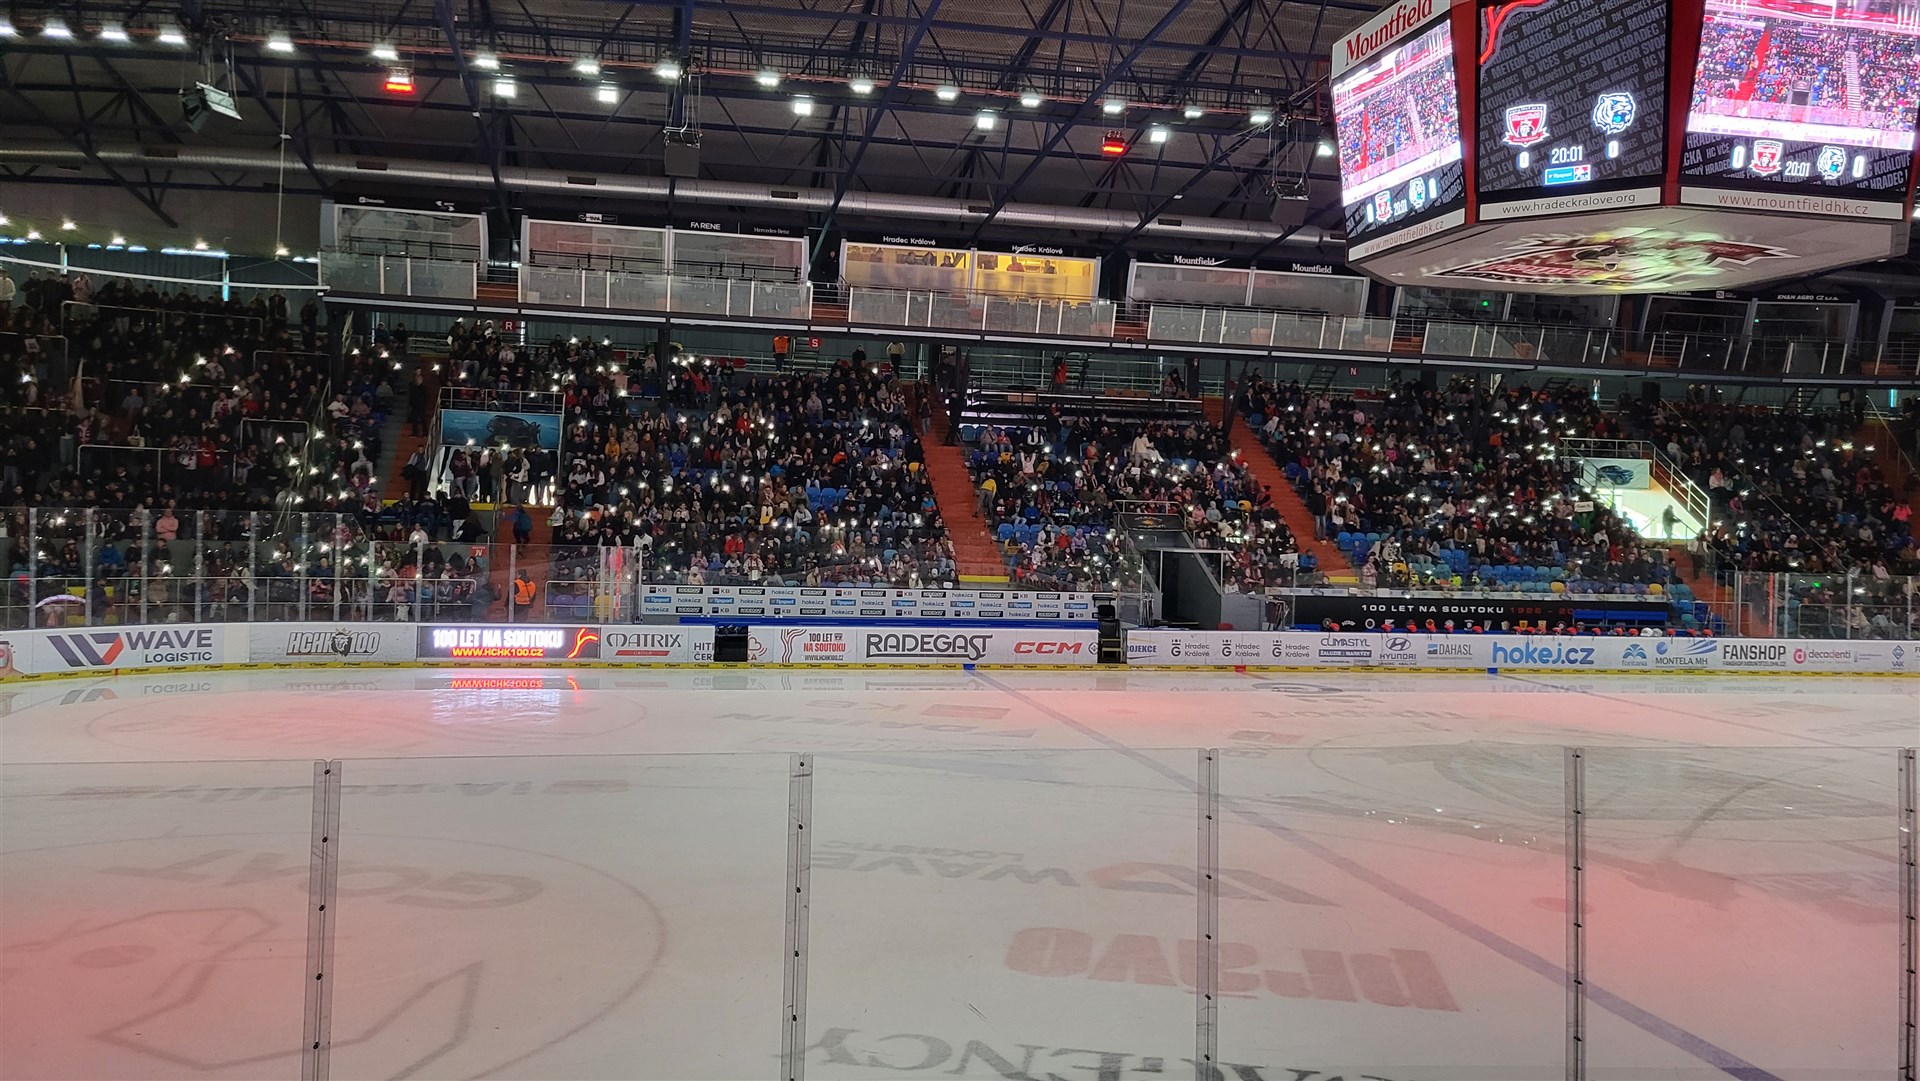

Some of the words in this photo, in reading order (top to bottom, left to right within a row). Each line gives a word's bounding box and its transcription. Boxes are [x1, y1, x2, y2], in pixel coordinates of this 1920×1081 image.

[1522, 1, 1579, 36] MOUNTFIELD
[1345, 0, 1432, 66] Mountfield
[1517, 28, 1553, 53] HRADEC
[1491, 55, 1528, 79] METEOR
[1527, 30, 1577, 63] SVOBODNÉ
[1576, 16, 1607, 40] DVORY
[1563, 38, 1595, 59] SPARTAK
[1595, 25, 1624, 45] HRADEC
[1579, 40, 1620, 68] STADION
[1620, 23, 1660, 50] HRADEC
[1601, 46, 1641, 73] METEOR
[1642, 54, 1658, 70] HC
[1522, 64, 1536, 80] HC
[1610, 63, 1640, 82] HRADEC
[1546, 78, 1573, 97] SPARTA
[1485, 84, 1524, 110] KUKLENY
[1553, 113, 1589, 137] HRADEC
[1551, 146, 1583, 164] 20:01
[1608, 141, 1618, 158] 0
[1732, 146, 1745, 169] 0
[1520, 151, 1529, 168] 0
[1853, 155, 1865, 178] 0
[1484, 167, 1498, 181] HC
[1497, 160, 1513, 175] LEV
[1785, 161, 1811, 177] 20:01
[1870, 171, 1904, 190] HRADEC
[1502, 192, 1636, 214] www.hradeckralove.org
[1718, 193, 1869, 215] www.mountfieldhk.cz
[753, 227, 790, 235] Mercedes-Benz
[1364, 220, 1444, 254] www.mountfieldhk.cz
[883, 236, 909, 244] Hradec
[910, 237, 936, 246] Králové
[1038, 246, 1063, 255] Králové
[1173, 255, 1216, 266] Mountfield
[1292, 263, 1333, 274] Mountfield
[505, 321, 513, 330] R
[811, 338, 819, 347] S
[1350, 367, 1357, 375] N
[1361, 604, 1386, 612] 100
[1419, 605, 1437, 613] NA
[1442, 606, 1505, 614] SOUTOKU
[125, 629, 213, 650] WAVE
[433, 629, 458, 648] 100
[460, 629, 482, 648] LET
[483, 629, 502, 648] NA
[504, 629, 563, 648] SOUTOKU
[606, 633, 682, 648] MATRIX
[809, 633, 821, 642] 100
[822, 633, 833, 642] LET
[1321, 638, 1370, 647] CLIMASTYL
[452, 648, 544, 657] WWW.HCHK100.CZ
[804, 643, 813, 652] NA
[814, 643, 846, 652] SOUTOKU
[866, 633, 993, 661] RADEGAST
[1014, 642, 1082, 654] CCM
[1127, 645, 1157, 653] OJEKCE
[1438, 643, 1473, 656] DAHASL
[1492, 641, 1595, 665] hokej.cz
[1723, 644, 1786, 660] FANSHOP
[1808, 649, 1851, 659] decadenti
[145, 651, 213, 663] LOGISTIC
[1655, 657, 1693, 665] MONTELA
[1695, 657, 1708, 665] MH
[821, 840, 1024, 861] LOGISTIC
[808, 850, 1081, 888] WAVE
